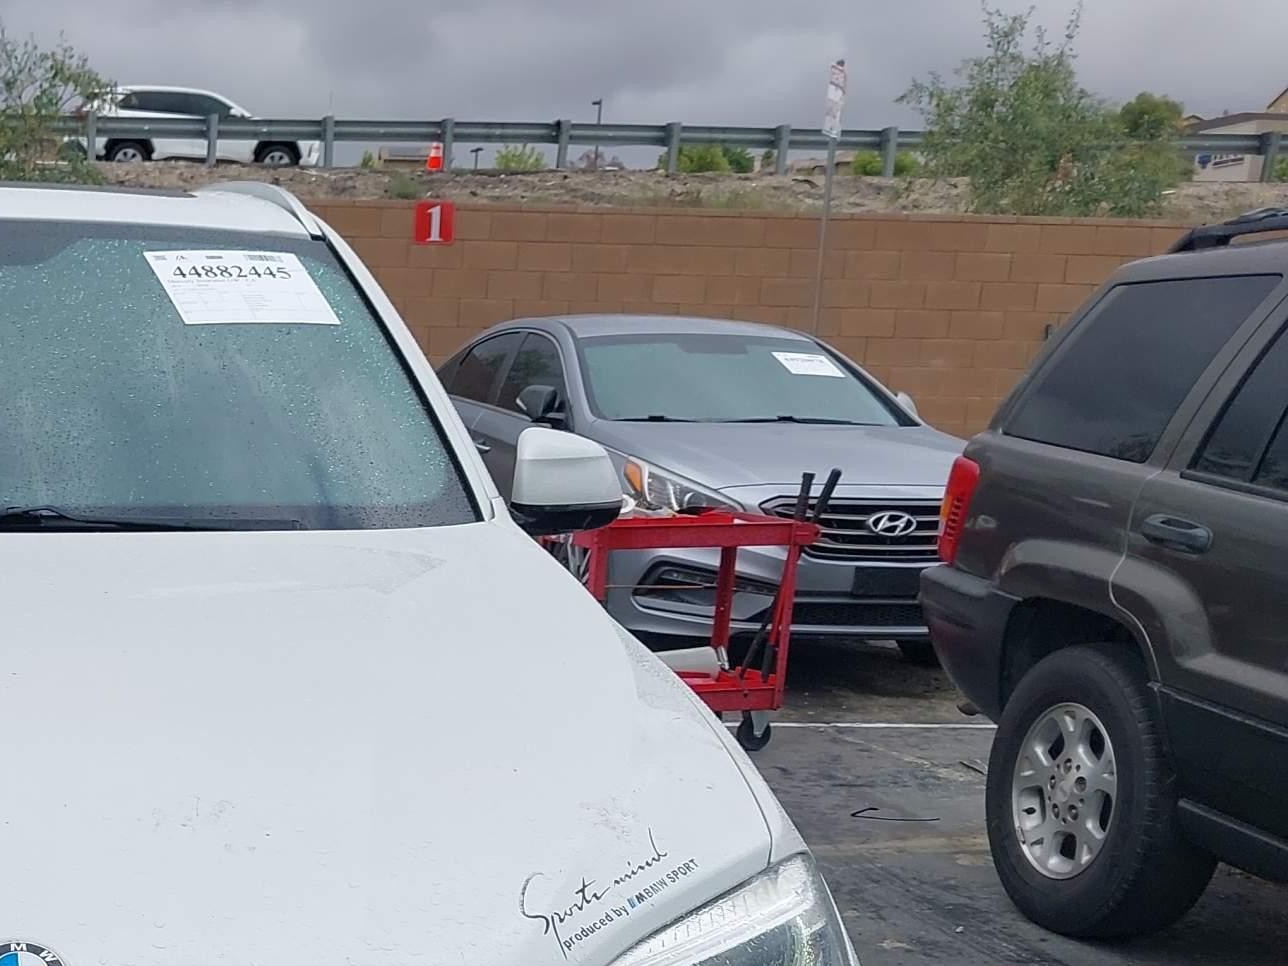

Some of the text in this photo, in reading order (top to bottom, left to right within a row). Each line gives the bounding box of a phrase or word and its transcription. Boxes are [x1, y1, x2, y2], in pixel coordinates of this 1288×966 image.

[426, 205, 443, 241] 1
[173, 264, 292, 280] 44882445
[563, 911, 615, 951] produced
[612, 904, 630, 917] by
[665, 858, 700, 883] SPORT
